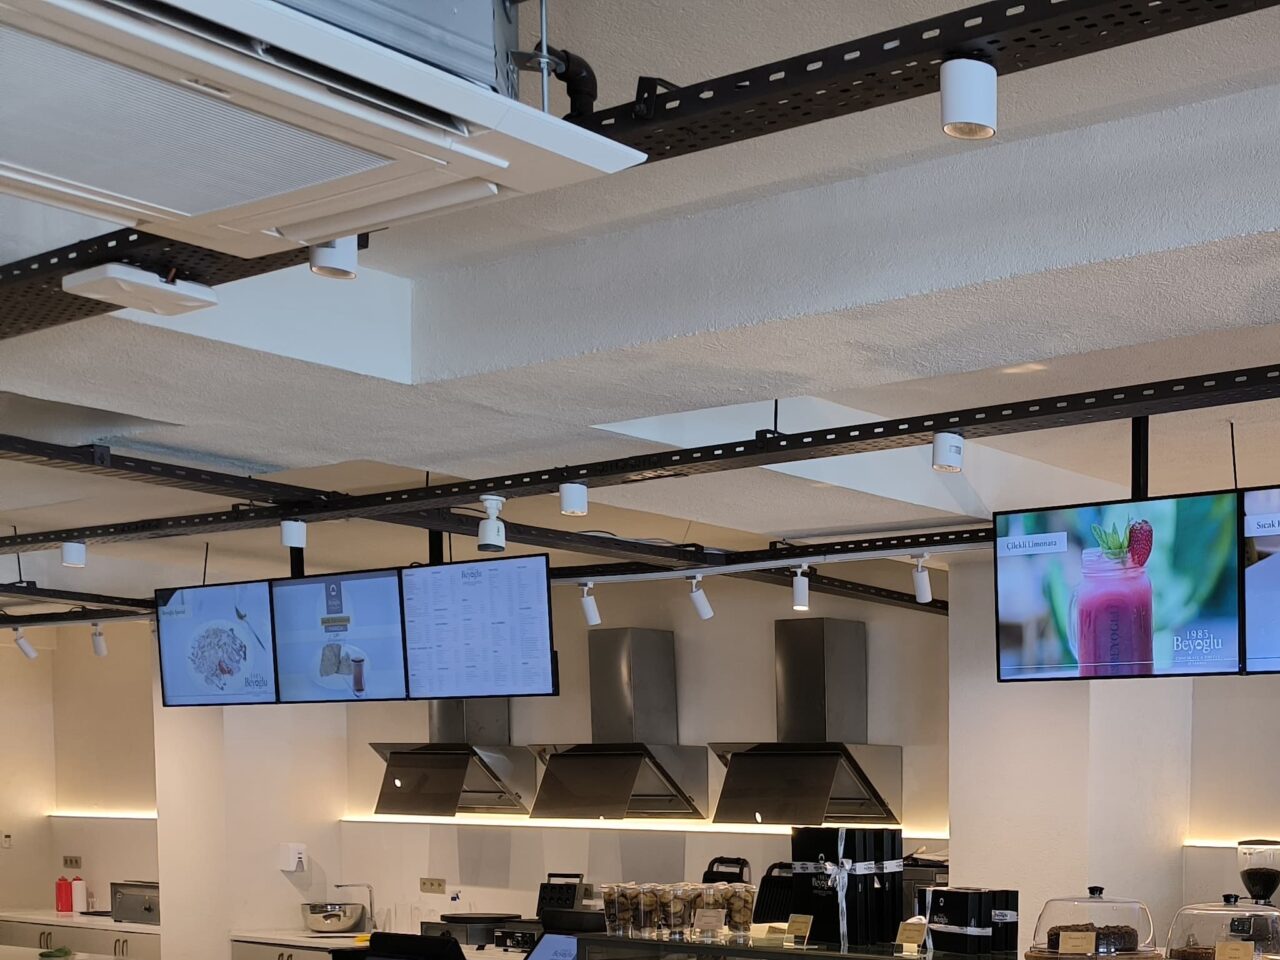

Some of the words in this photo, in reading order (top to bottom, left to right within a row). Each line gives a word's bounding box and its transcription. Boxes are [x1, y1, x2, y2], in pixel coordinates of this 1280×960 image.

[1256, 519, 1277, 529] Sıcak
[1006, 541, 1028, 552] Çilekli
[1028, 540, 1058, 549] Limonata
[1186, 629, 1209, 640] 1983
